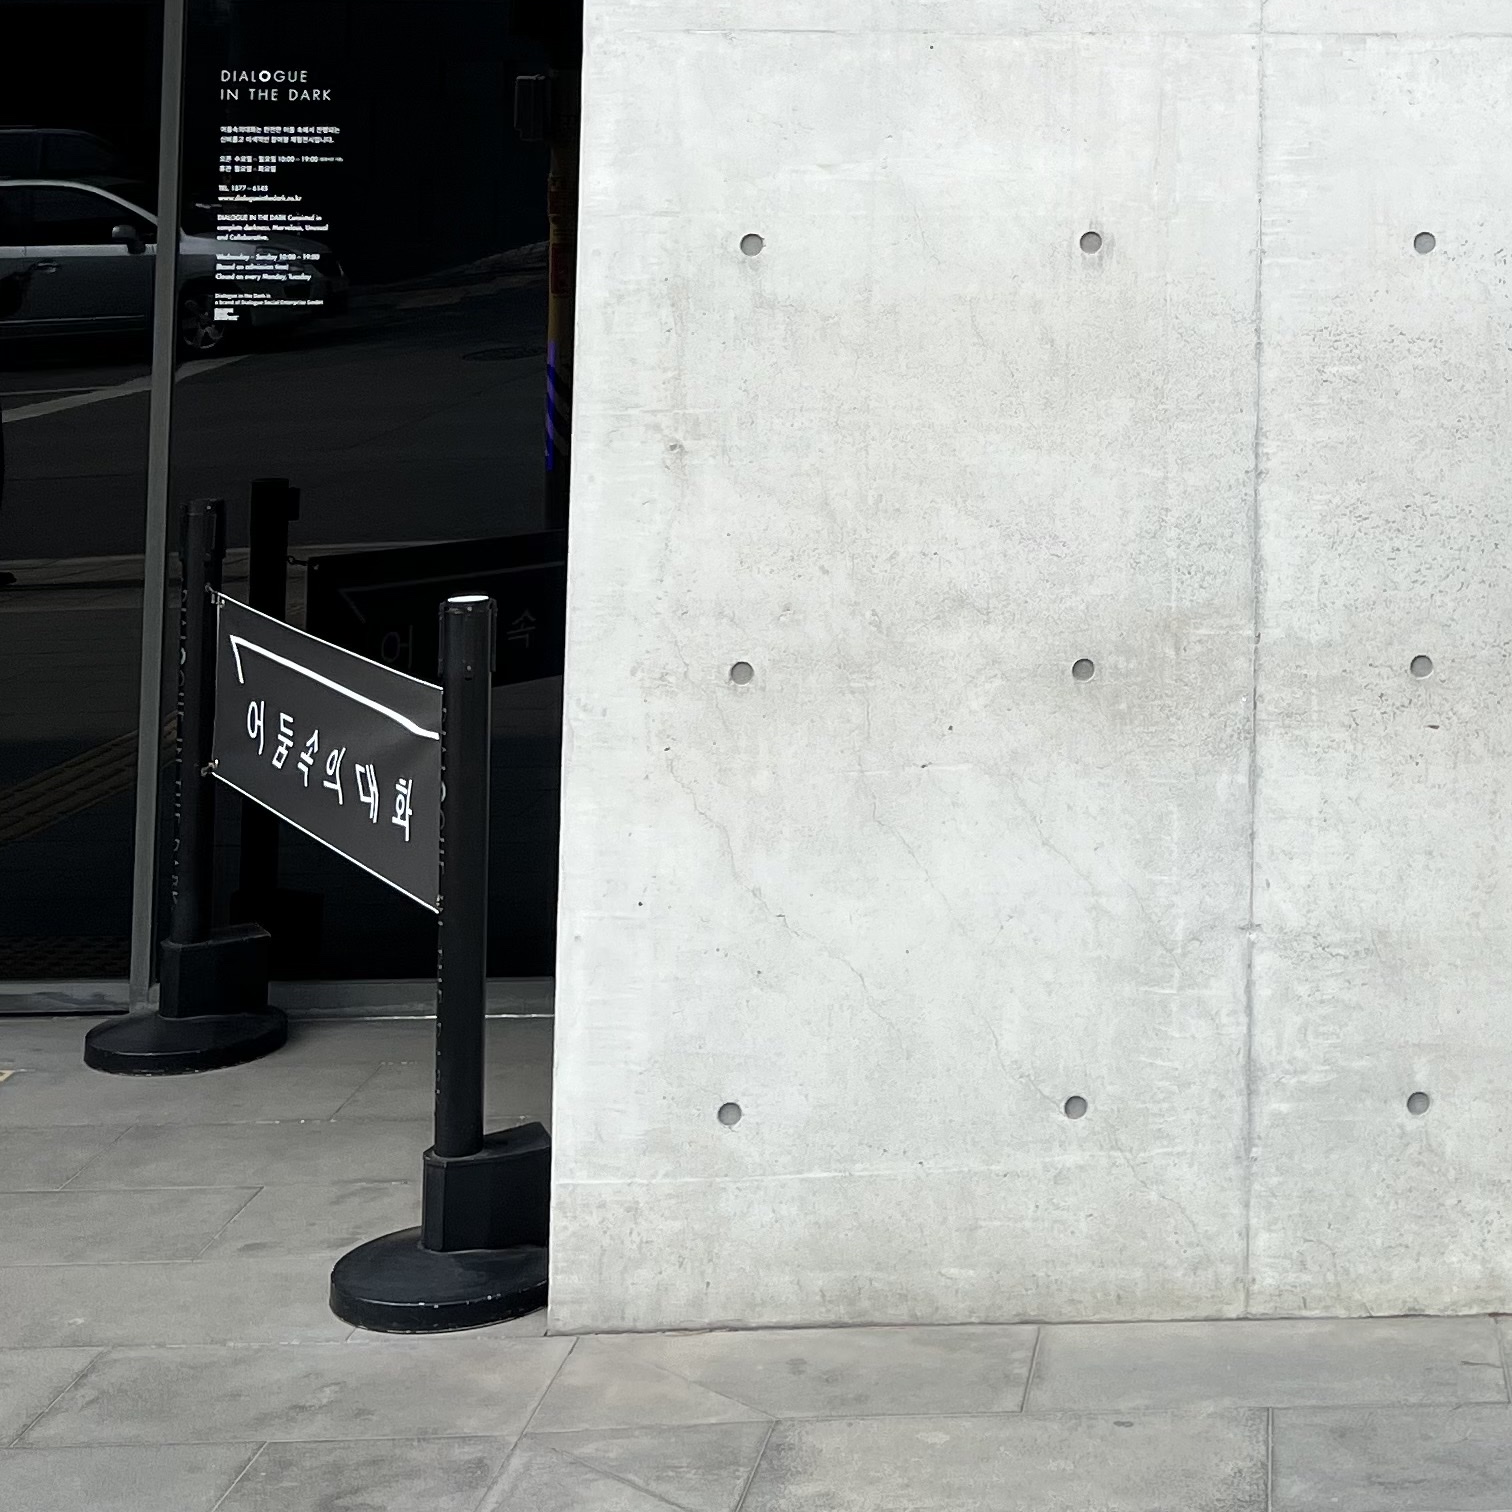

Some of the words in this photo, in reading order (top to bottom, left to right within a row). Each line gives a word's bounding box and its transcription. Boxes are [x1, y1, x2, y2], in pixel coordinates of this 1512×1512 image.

[220, 69, 308, 83] DIALOGUE
[220, 88, 239, 101] IN
[248, 88, 279, 101] THE
[288, 88, 332, 101] DARK
